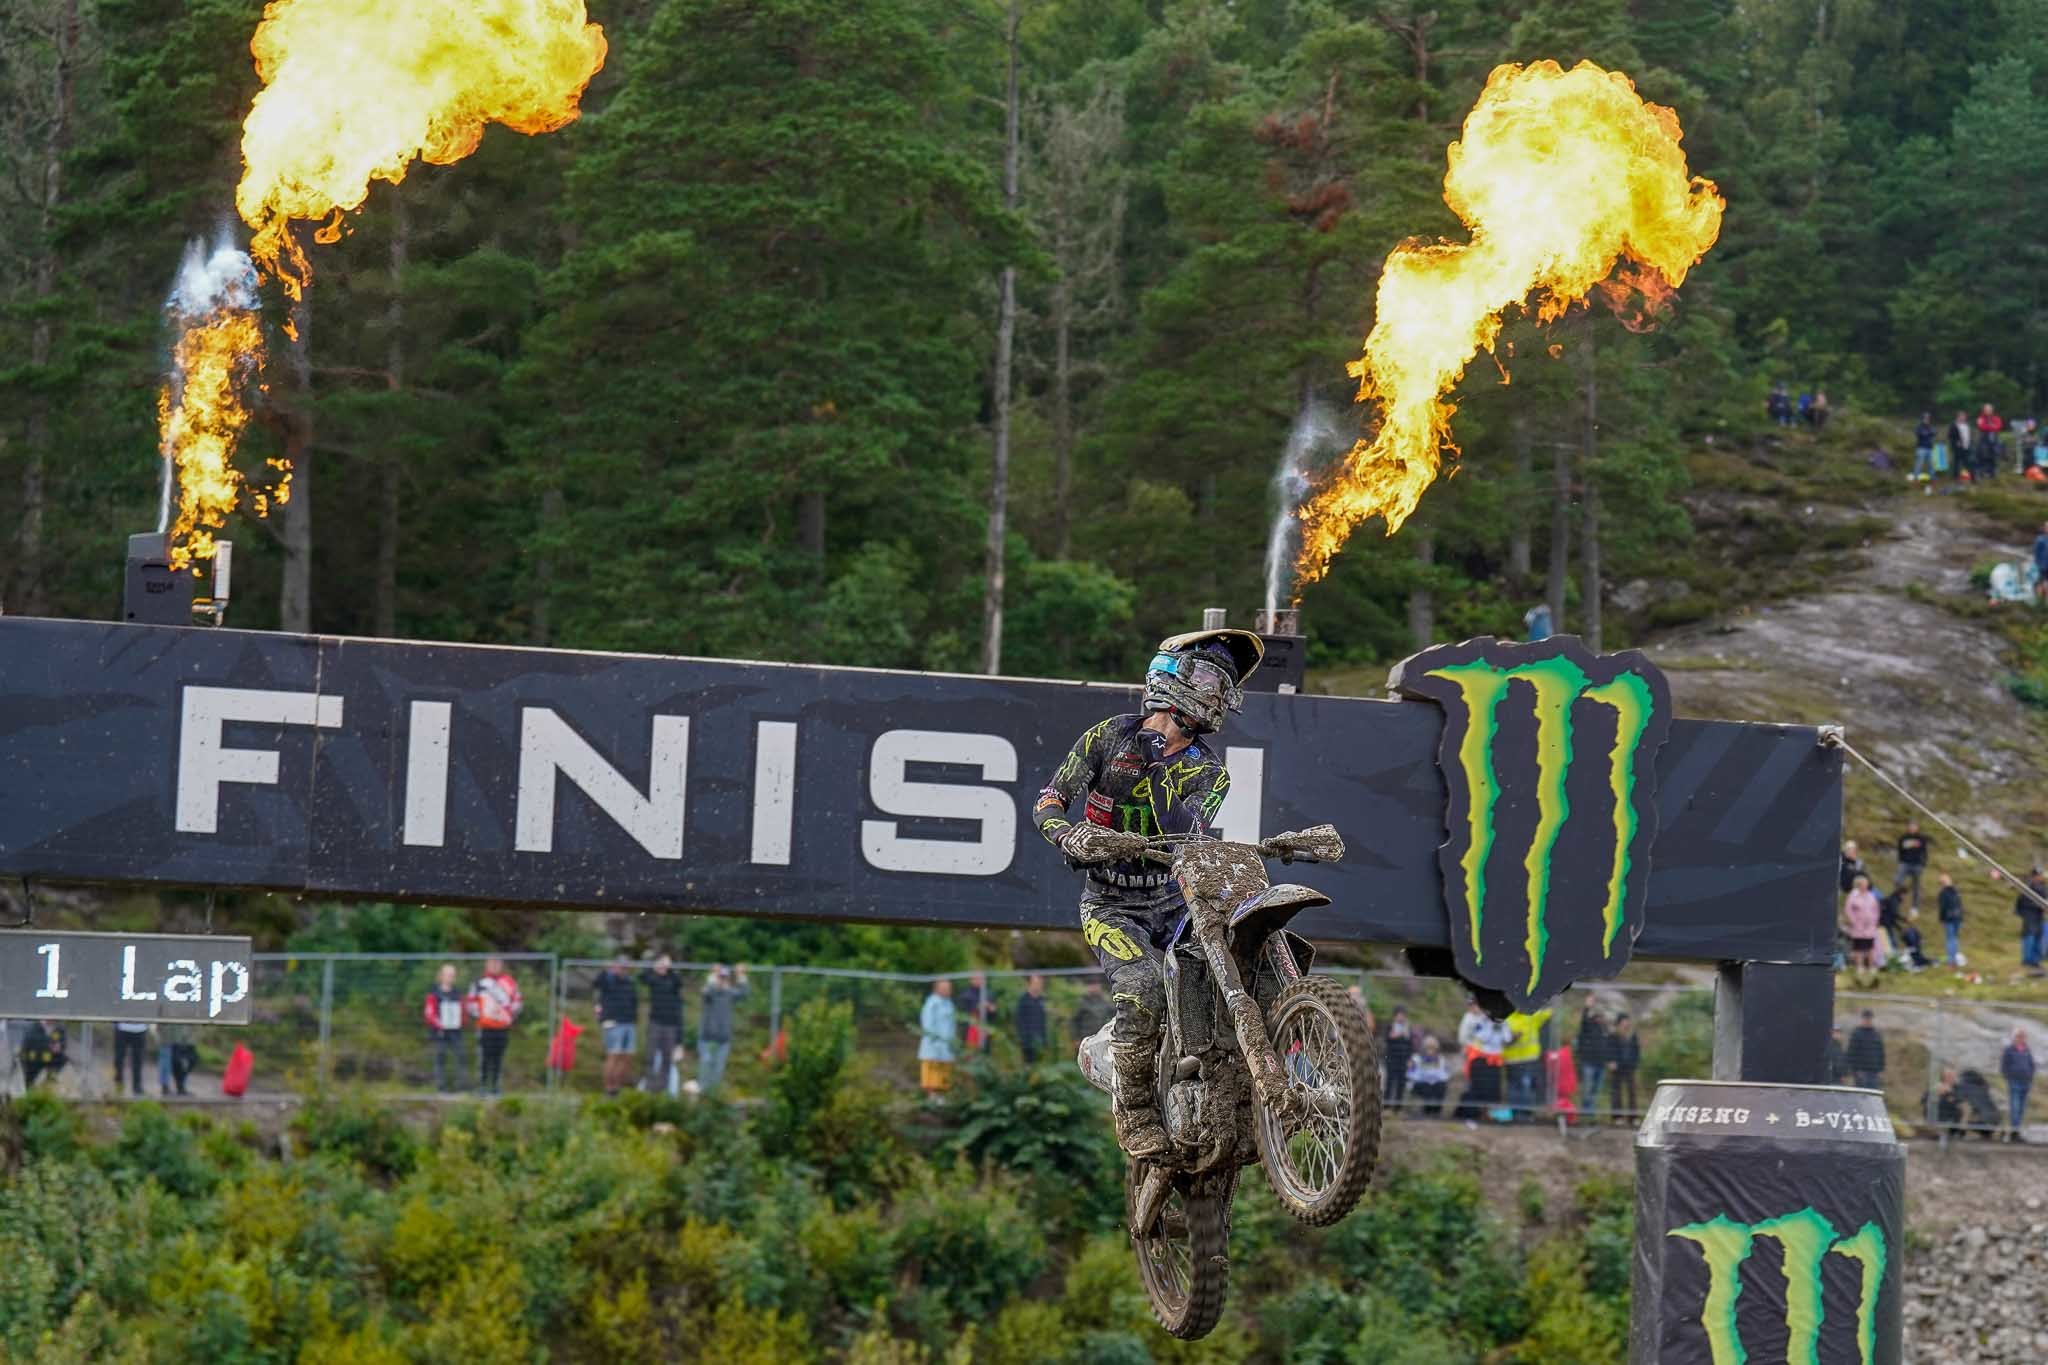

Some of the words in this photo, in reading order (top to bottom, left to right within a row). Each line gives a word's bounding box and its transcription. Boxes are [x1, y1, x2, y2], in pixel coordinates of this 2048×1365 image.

[1106, 868, 1169, 888] YAMAH
[35, 943, 69, 998] 1
[121, 945, 249, 1018] Lap
